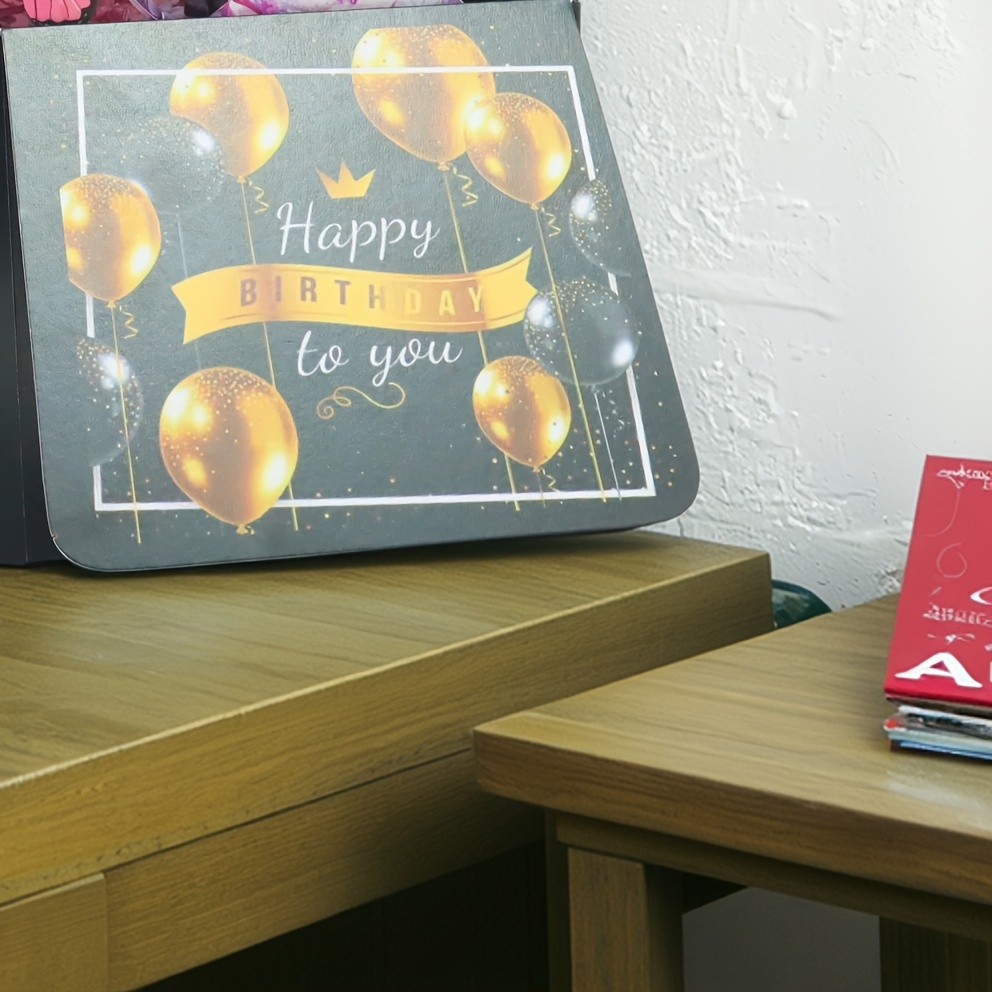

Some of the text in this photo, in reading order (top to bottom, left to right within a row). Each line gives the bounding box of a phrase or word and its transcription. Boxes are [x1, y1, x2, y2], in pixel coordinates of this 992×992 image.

[276, 201, 440, 263] Happy
[239, 275, 485, 316] BIRTHDAY
[296, 330, 463, 387] to you
